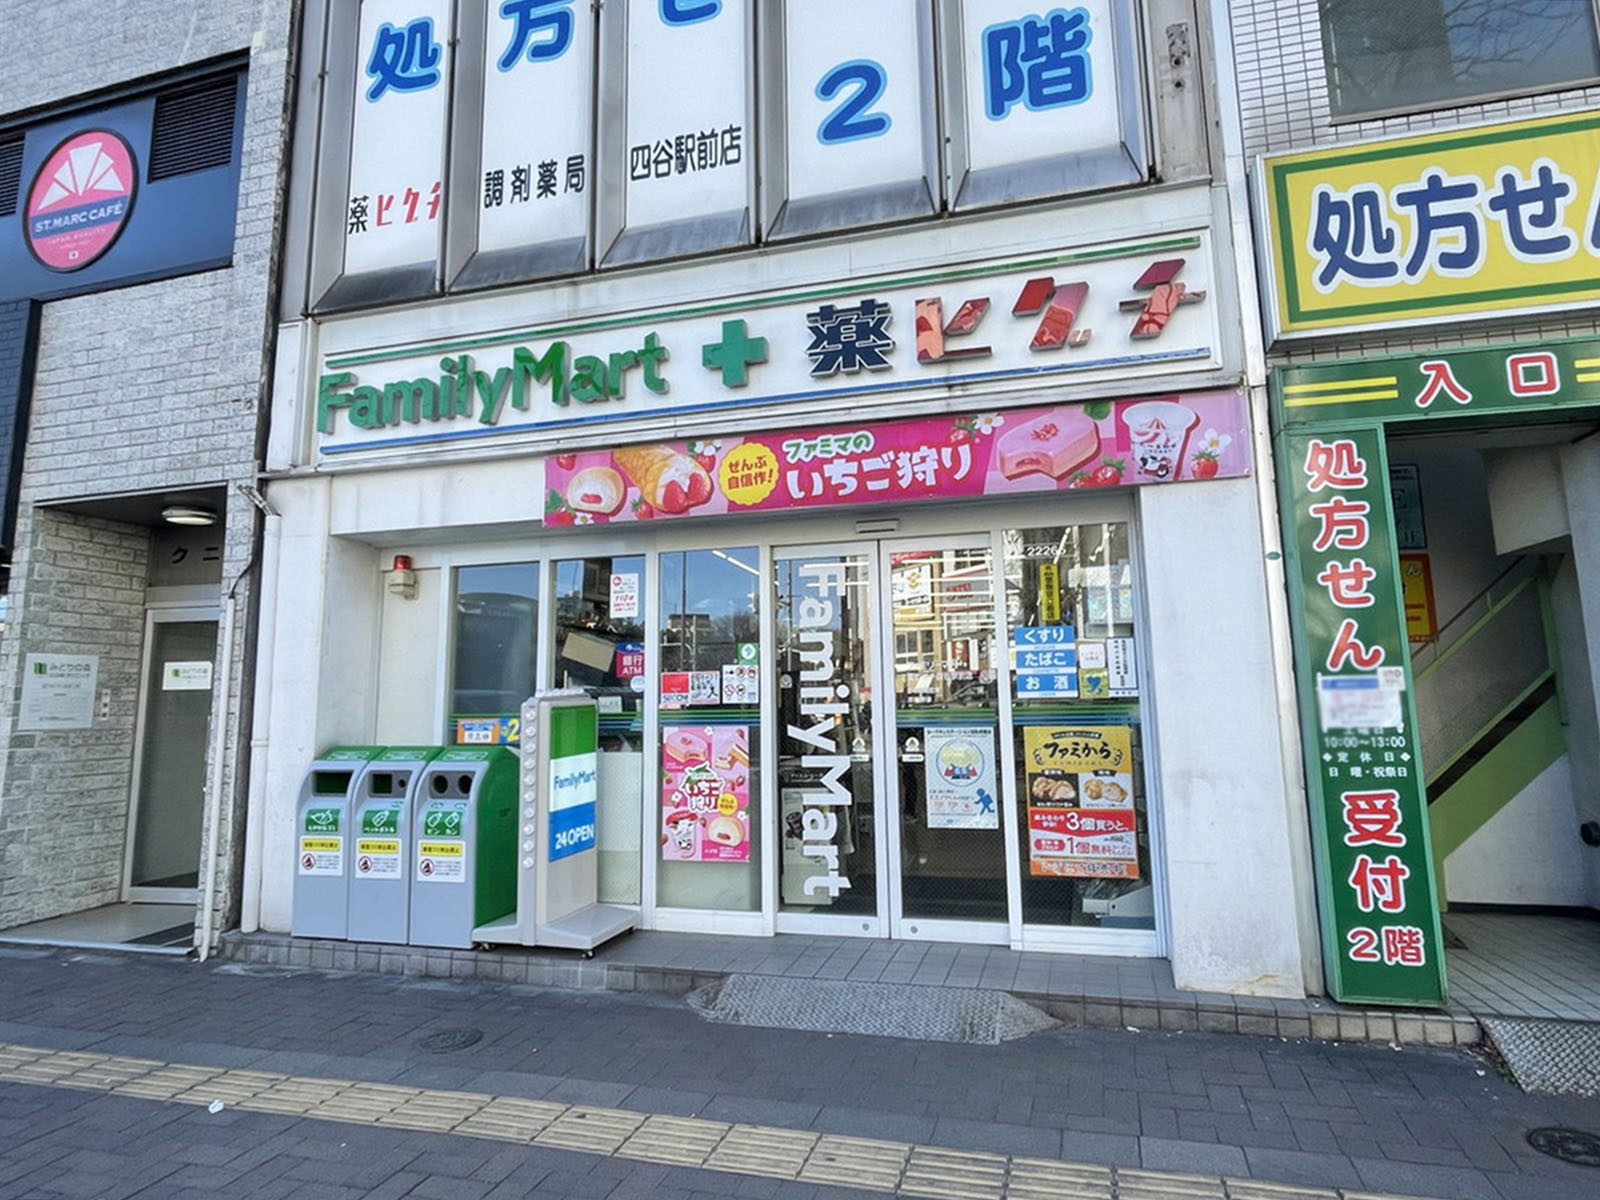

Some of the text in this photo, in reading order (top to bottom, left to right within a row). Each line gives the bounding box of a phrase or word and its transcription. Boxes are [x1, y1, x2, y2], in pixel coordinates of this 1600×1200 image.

[630, 124, 742, 182] 四谷駅前店
[484, 154, 585, 209] 調剤薬局
[1308, 158, 1600, 293] 処方せ
[317, 331, 670, 434] FamilyMart
[1414, 353, 1562, 408] 入口
[783, 431, 875, 465] ファミマの
[786, 443, 973, 500] いちご狩り
[1304, 439, 1385, 672] 処方せん
[1024, 628, 1064, 643] くすり
[1025, 652, 1066, 666] たばこ
[786, 565, 852, 898] FamilyMart
[1043, 741, 1111, 759] ファミから
[554, 770, 597, 790] FamilyMart
[1341, 790, 1411, 913] 受付
[1347, 926, 1425, 966] 2階
